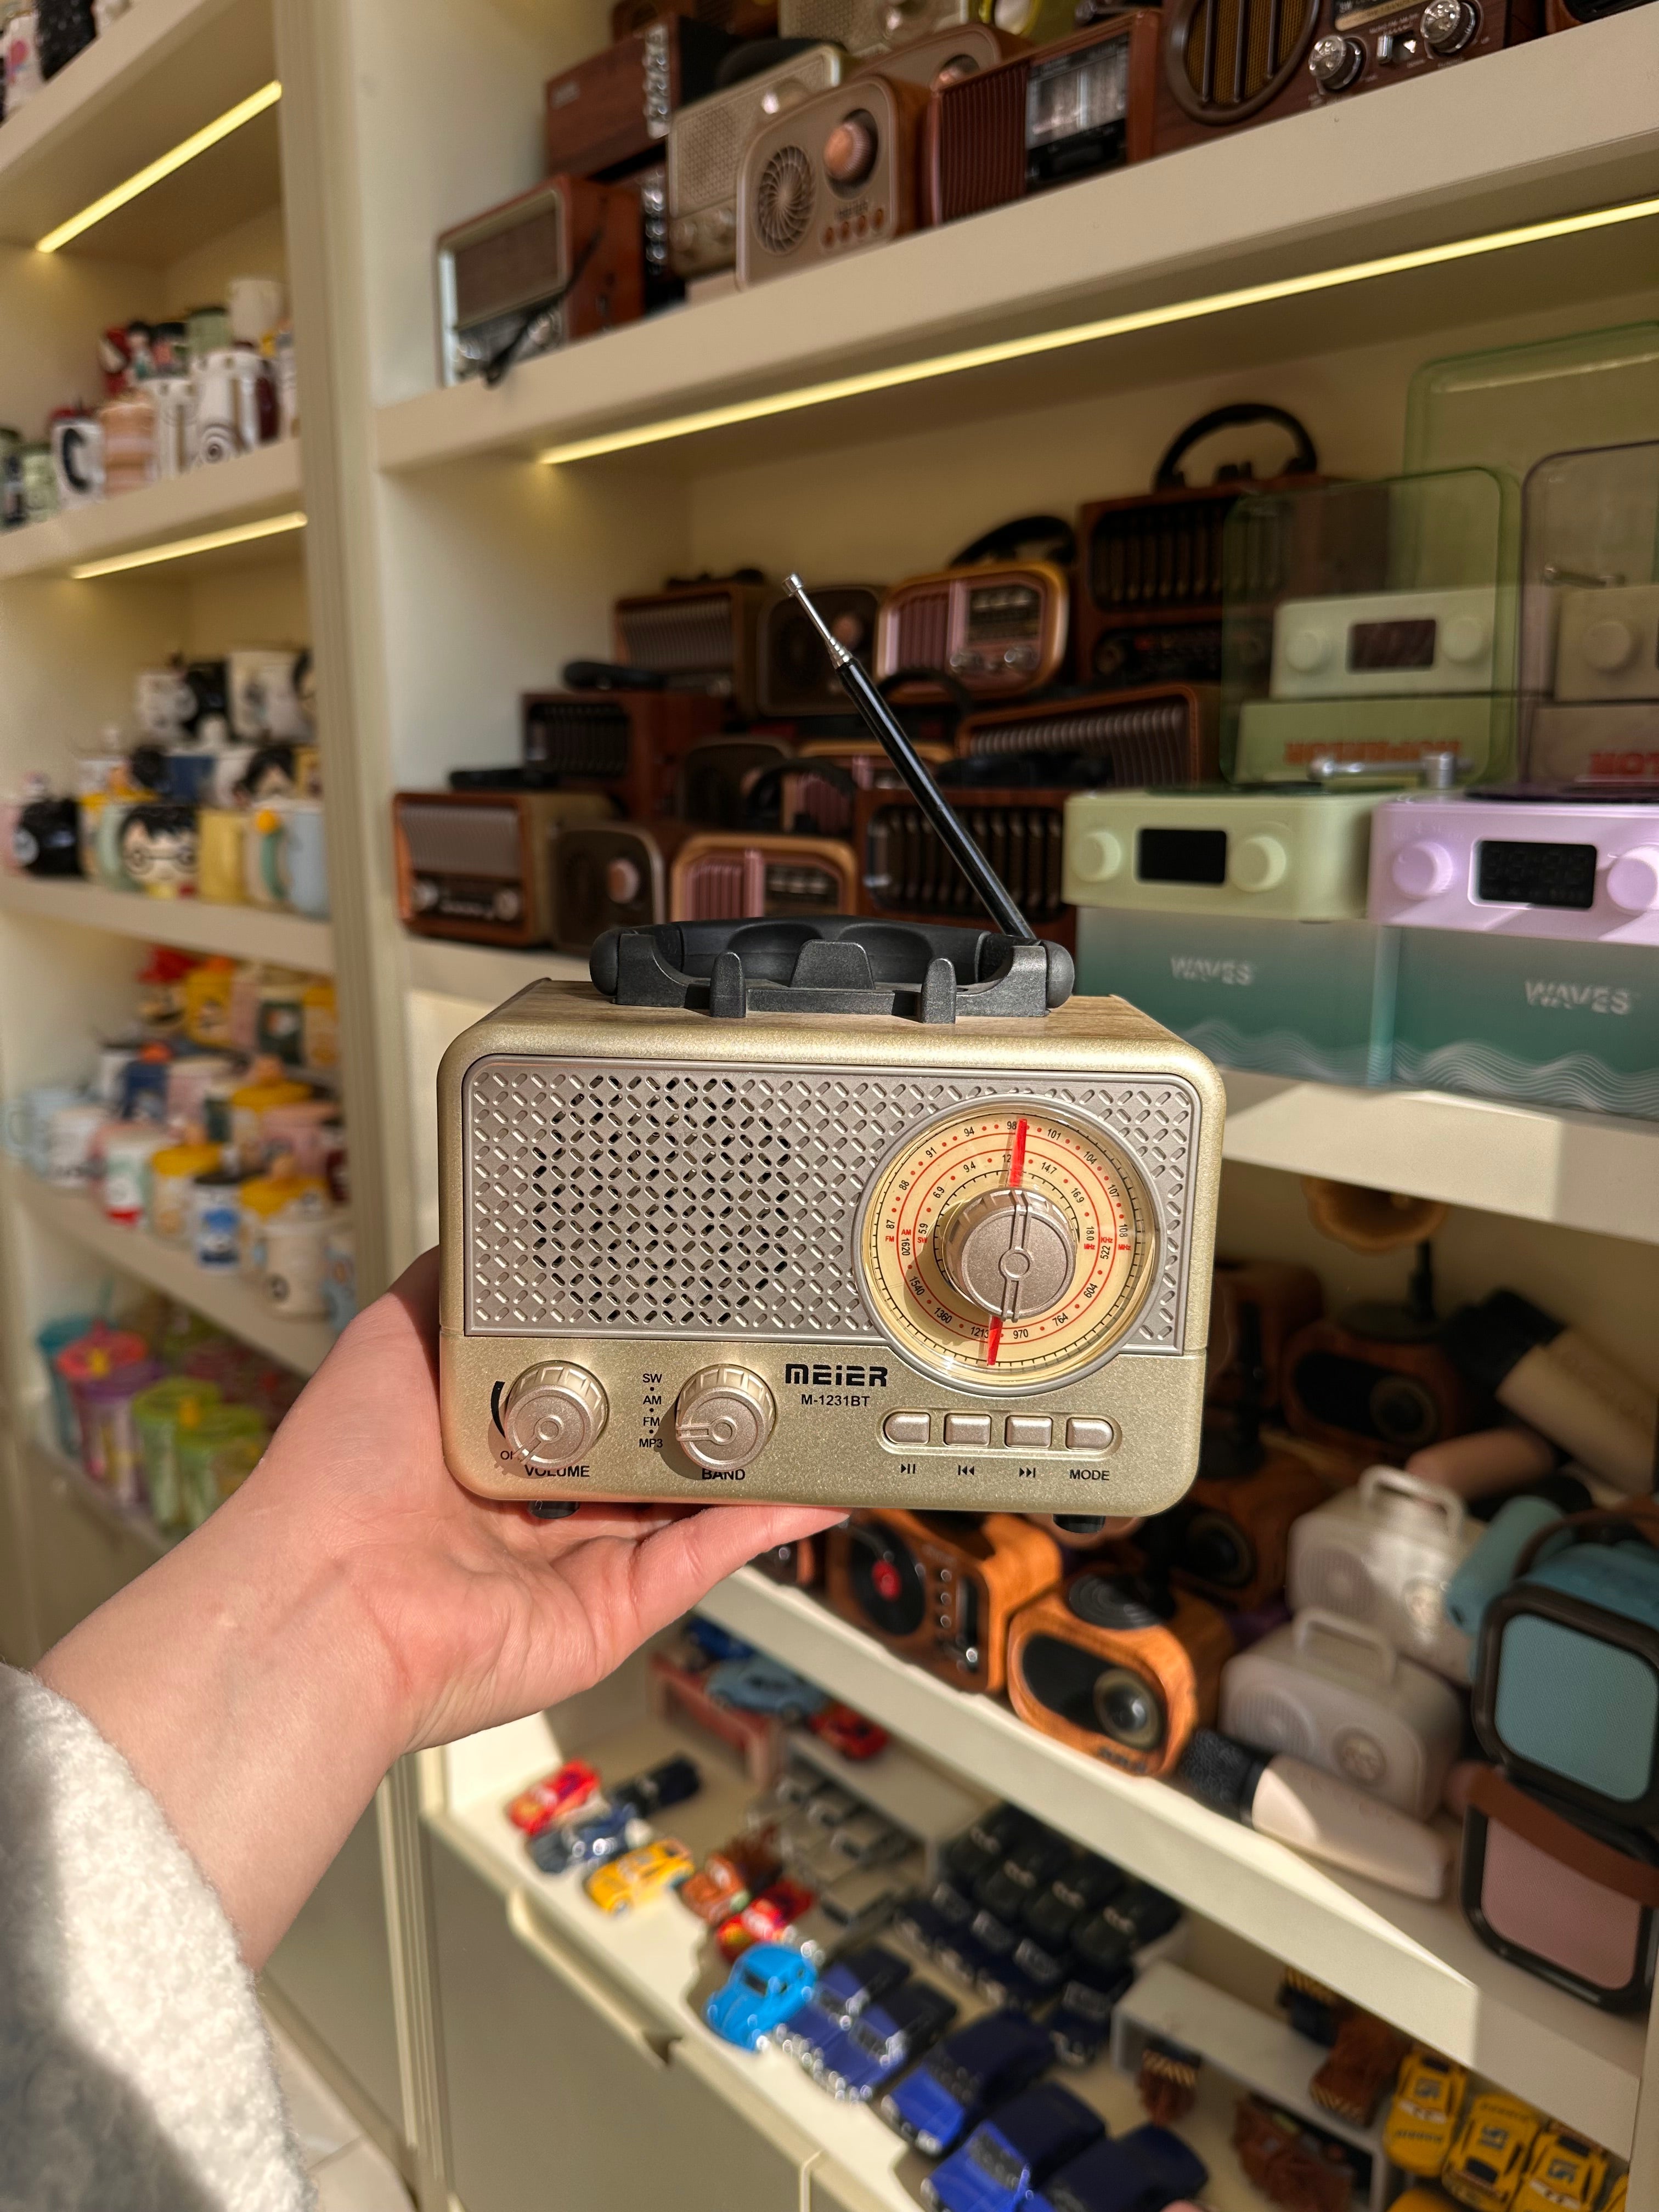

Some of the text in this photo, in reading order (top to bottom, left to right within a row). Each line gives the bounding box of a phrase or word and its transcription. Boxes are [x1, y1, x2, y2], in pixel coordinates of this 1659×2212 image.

[1525, 980, 1630, 1015] WAVES
[964, 1127, 974, 1136] 94
[1047, 1128, 1061, 1140] 101
[926, 1147, 936, 1158] 91
[1083, 1151, 1098, 1165] 104
[963, 1161, 976, 1172] 9.4
[1042, 1162, 1057, 1175] 14.7
[899, 1180, 909, 1190] 88
[1108, 1184, 1120, 1198] 107
[933, 1186, 945, 1198] 6.9
[1071, 1188, 1085, 1203] 16.9
[886, 1220, 895, 1229] 87
[1119, 1223, 1128, 1237] 108
[1086, 1226, 1094, 1241] 18.0
[901, 1238, 911, 1256] 1620
[1100, 1245, 1110, 1260] 522
[909, 1276, 925, 1295] 1540
[1084, 1283, 1098, 1298] 604
[934, 1307, 952, 1324] 1360
[1052, 1313, 1069, 1326] 764
[1013, 1329, 1029, 1339] 970
[642, 1373, 662, 1383] SW
[643, 1395, 662, 1405] AM
[801, 1394, 870, 1406] M-1231BT
[643, 1417, 660, 1426] FM
[639, 1438, 663, 1448] MP3
[702, 1468, 745, 1480] BAND
[1070, 1469, 1109, 1481] MODE
